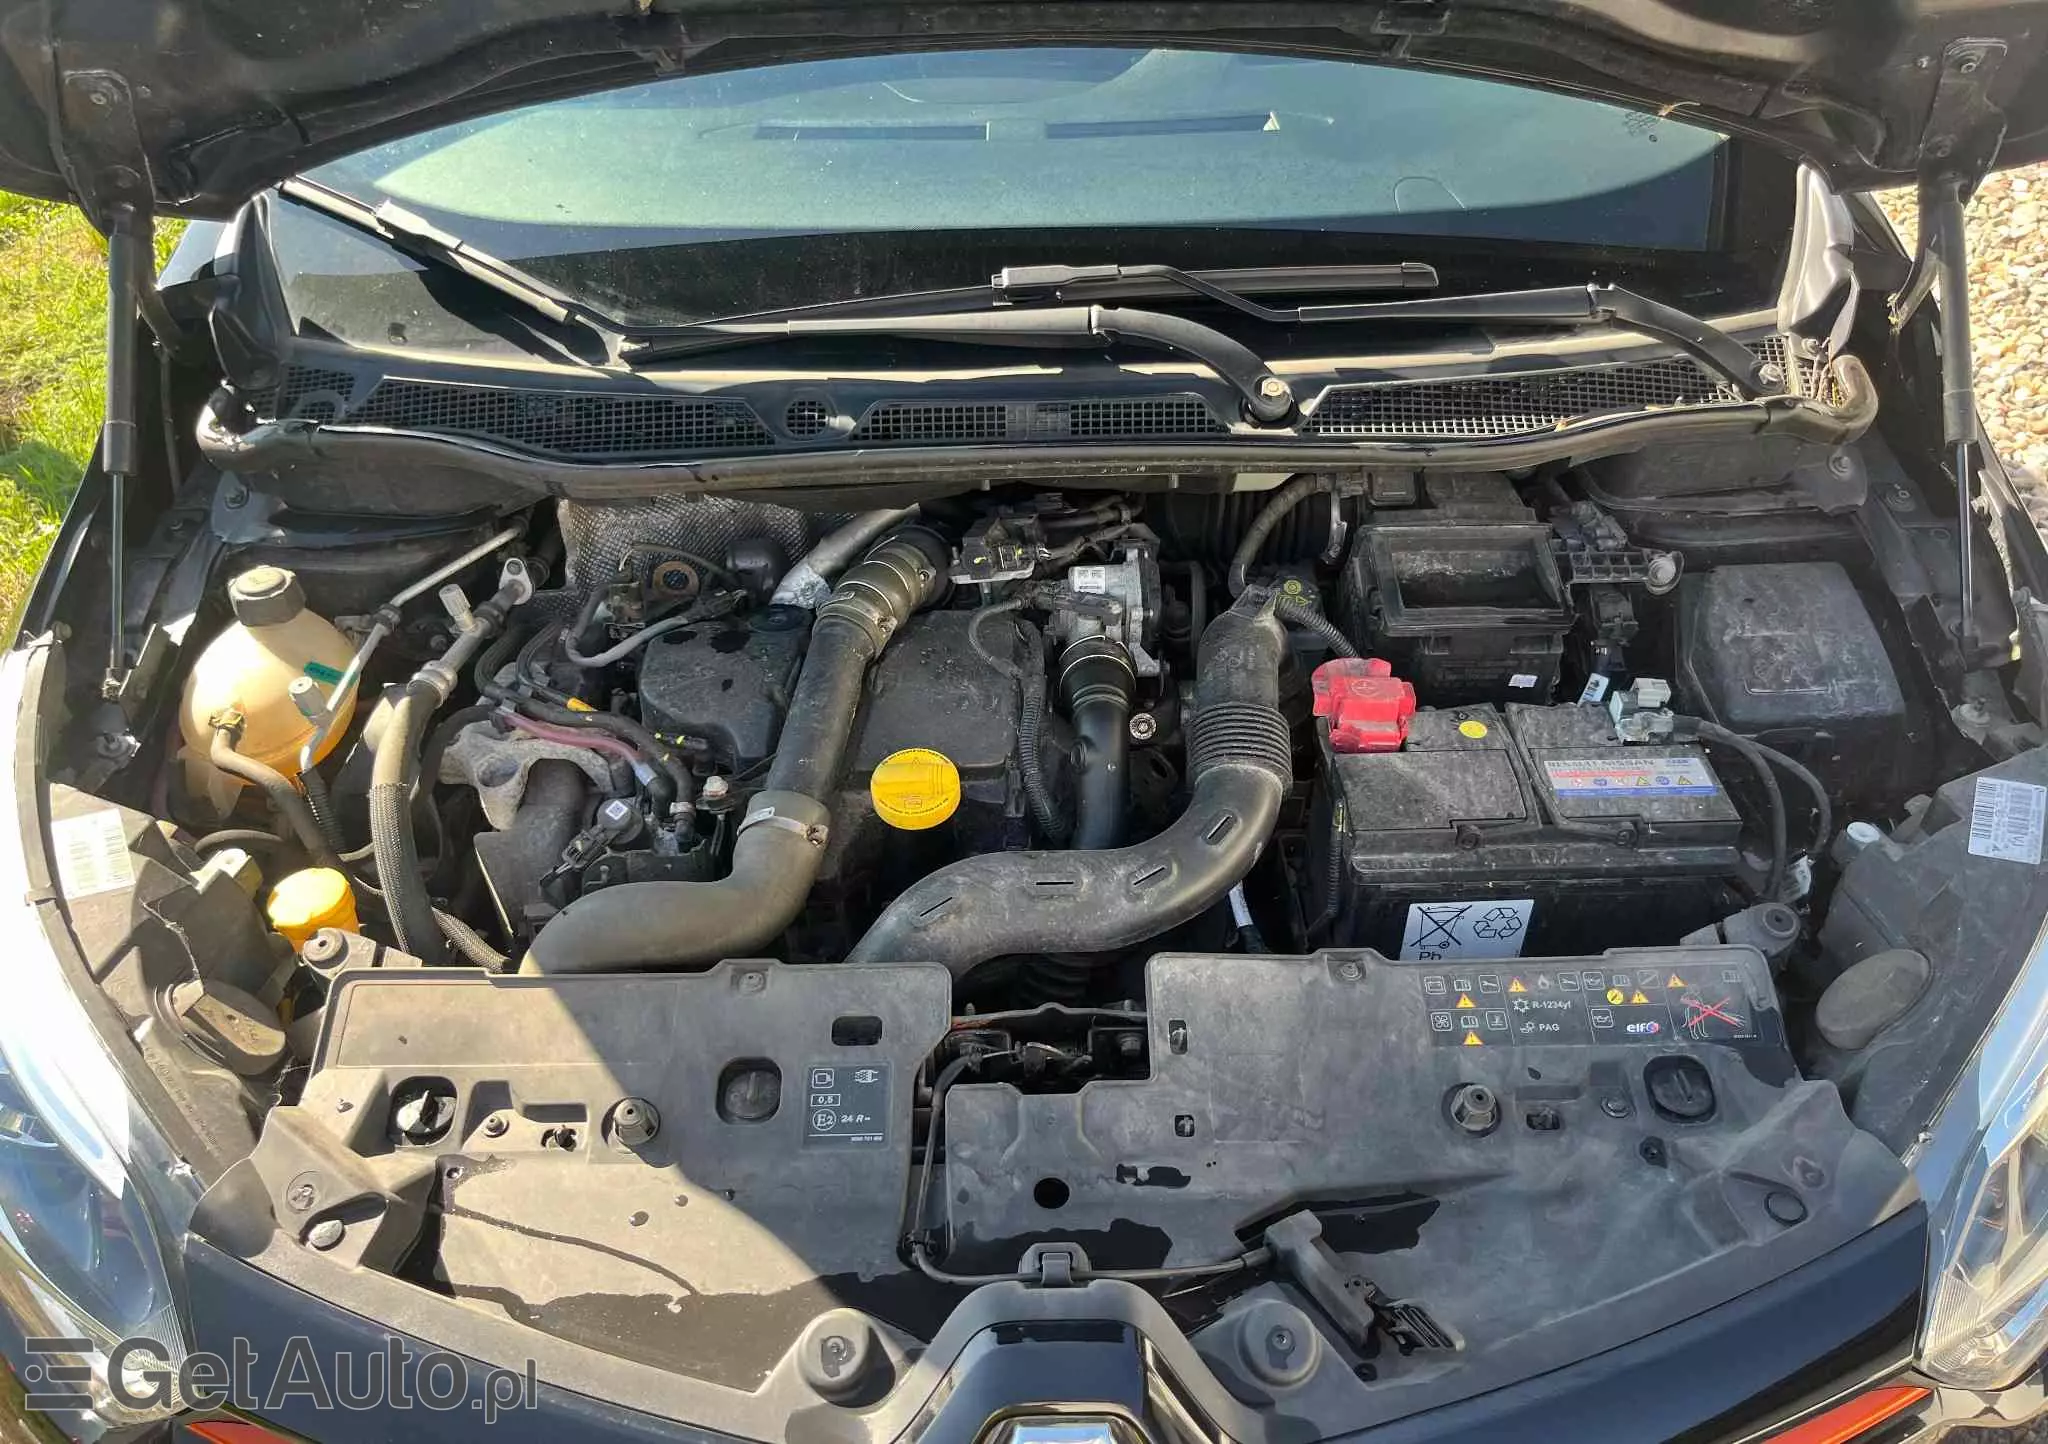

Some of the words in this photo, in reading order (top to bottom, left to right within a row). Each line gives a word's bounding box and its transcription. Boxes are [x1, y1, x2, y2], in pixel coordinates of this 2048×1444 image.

[1532, 1000, 1571, 1010] R-1234yf
[1539, 1023, 1561, 1032] PAG
[1626, 1023, 1648, 1033] elf
